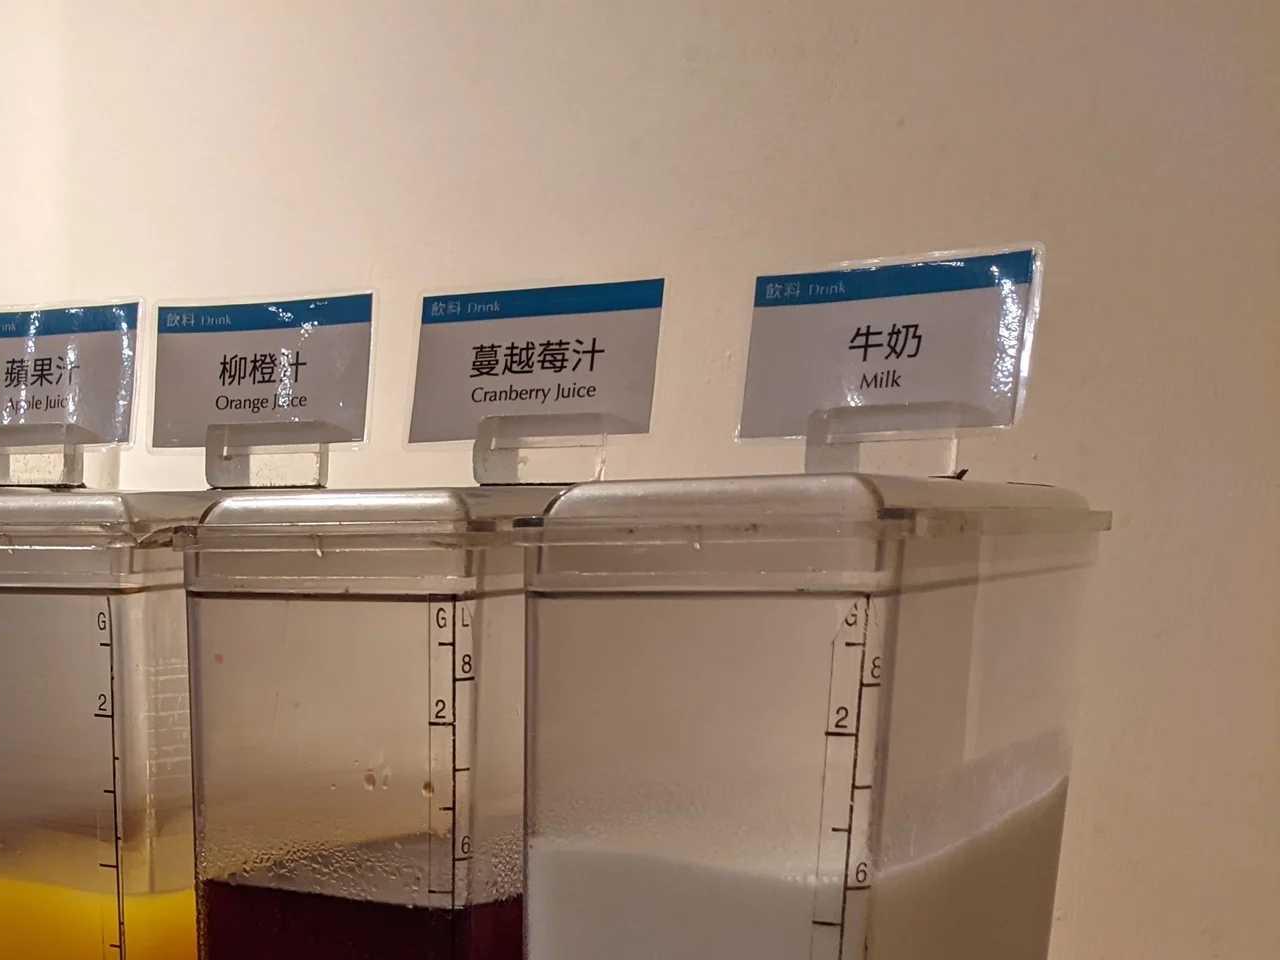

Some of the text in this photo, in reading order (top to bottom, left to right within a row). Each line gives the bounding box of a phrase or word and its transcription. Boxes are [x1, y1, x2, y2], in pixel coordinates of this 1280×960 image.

[808, 280, 846, 296] Drink
[468, 299, 500, 314] Drink
[201, 313, 232, 326] Drink
[848, 323, 922, 362] 牛奶
[469, 337, 605, 378] 蔓越莓汁
[4, 356, 80, 388] 蘋果汁
[218, 351, 307, 387] 柳橙汁
[860, 369, 902, 390] Milk
[44, 395, 74, 412] Juic
[215, 393, 308, 414] Orange Jce
[471, 382, 596, 404] Cranberry Juice
[97, 611, 107, 631] G
[436, 608, 448, 629] G
[461, 654, 473, 675] 8
[98, 694, 107, 711] 2
[434, 699, 446, 719] 2
[834, 706, 849, 729] 2
[460, 836, 471, 855] 6
[855, 862, 868, 883] 6
